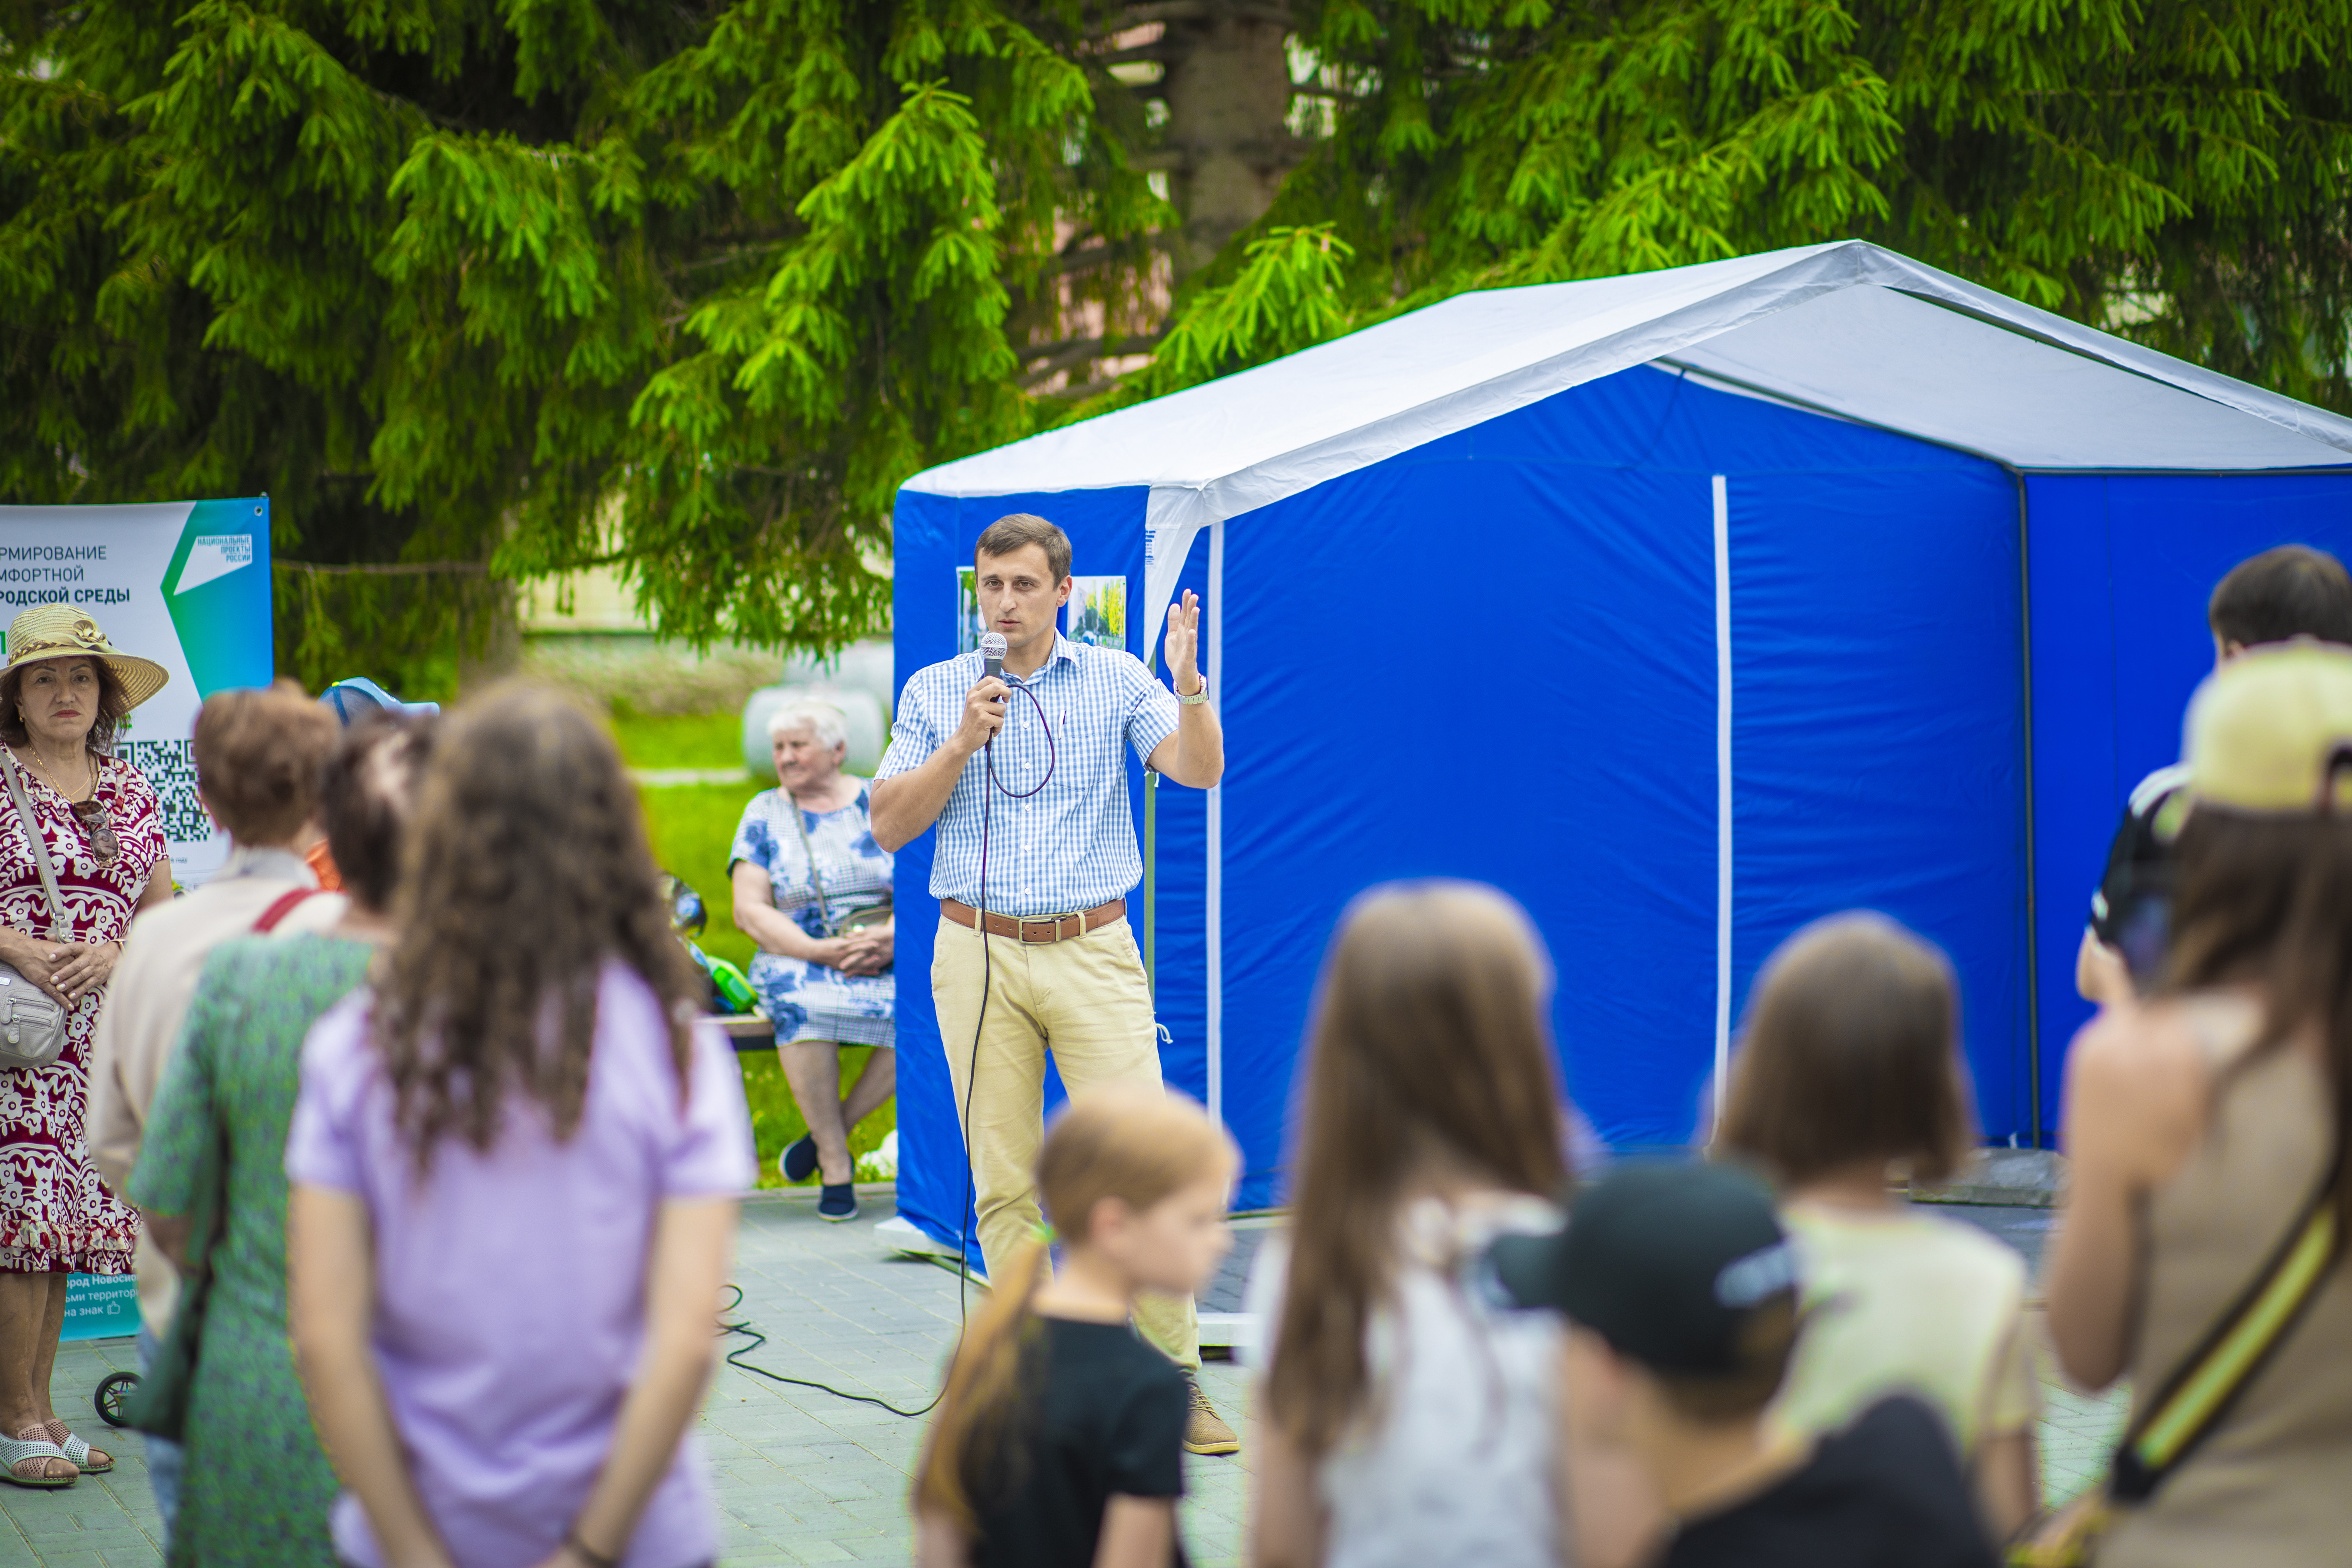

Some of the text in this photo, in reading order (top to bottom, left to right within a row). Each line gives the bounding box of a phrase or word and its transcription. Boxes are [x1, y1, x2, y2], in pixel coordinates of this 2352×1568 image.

[198, 536, 250, 547] НАЦИОНАЛЬНЫЕ
[0, 545, 107, 561] РМИРОВАНИЕ
[221, 545, 251, 554] ПРОЕКТЫ
[226, 554, 251, 563] РОССИИ
[75, 588, 130, 605] СРЕДЫ
[79, 1306, 104, 1316] знак
